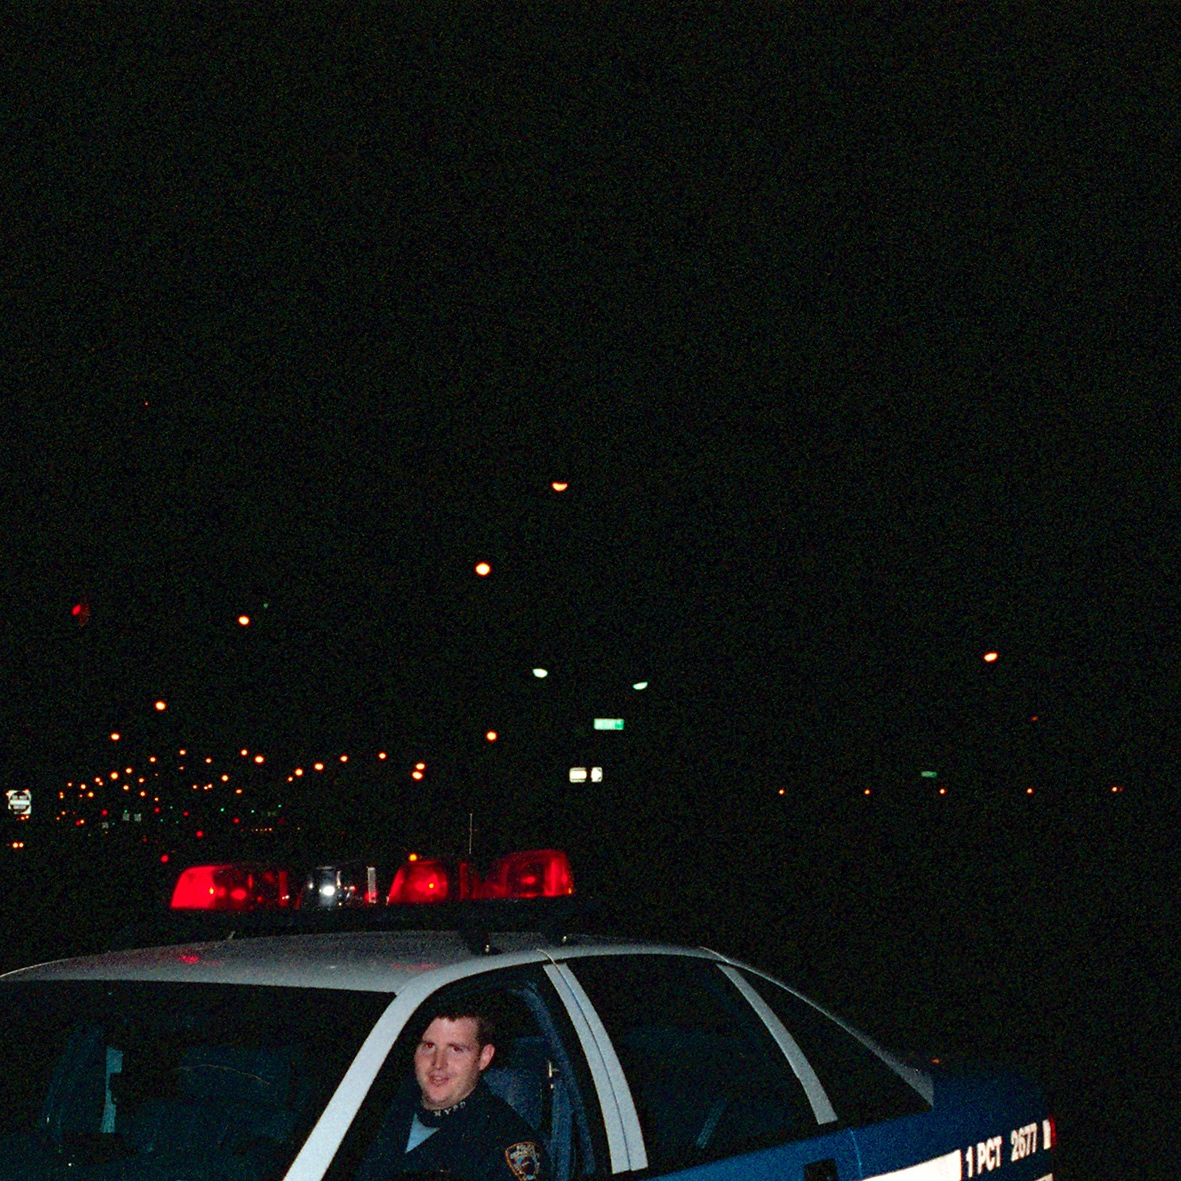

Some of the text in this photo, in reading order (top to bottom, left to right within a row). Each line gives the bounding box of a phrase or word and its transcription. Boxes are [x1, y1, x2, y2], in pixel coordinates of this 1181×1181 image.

[434, 1101, 466, 1117] NYPD
[965, 1146, 974, 1178] 1
[976, 1136, 1003, 1175] PCT
